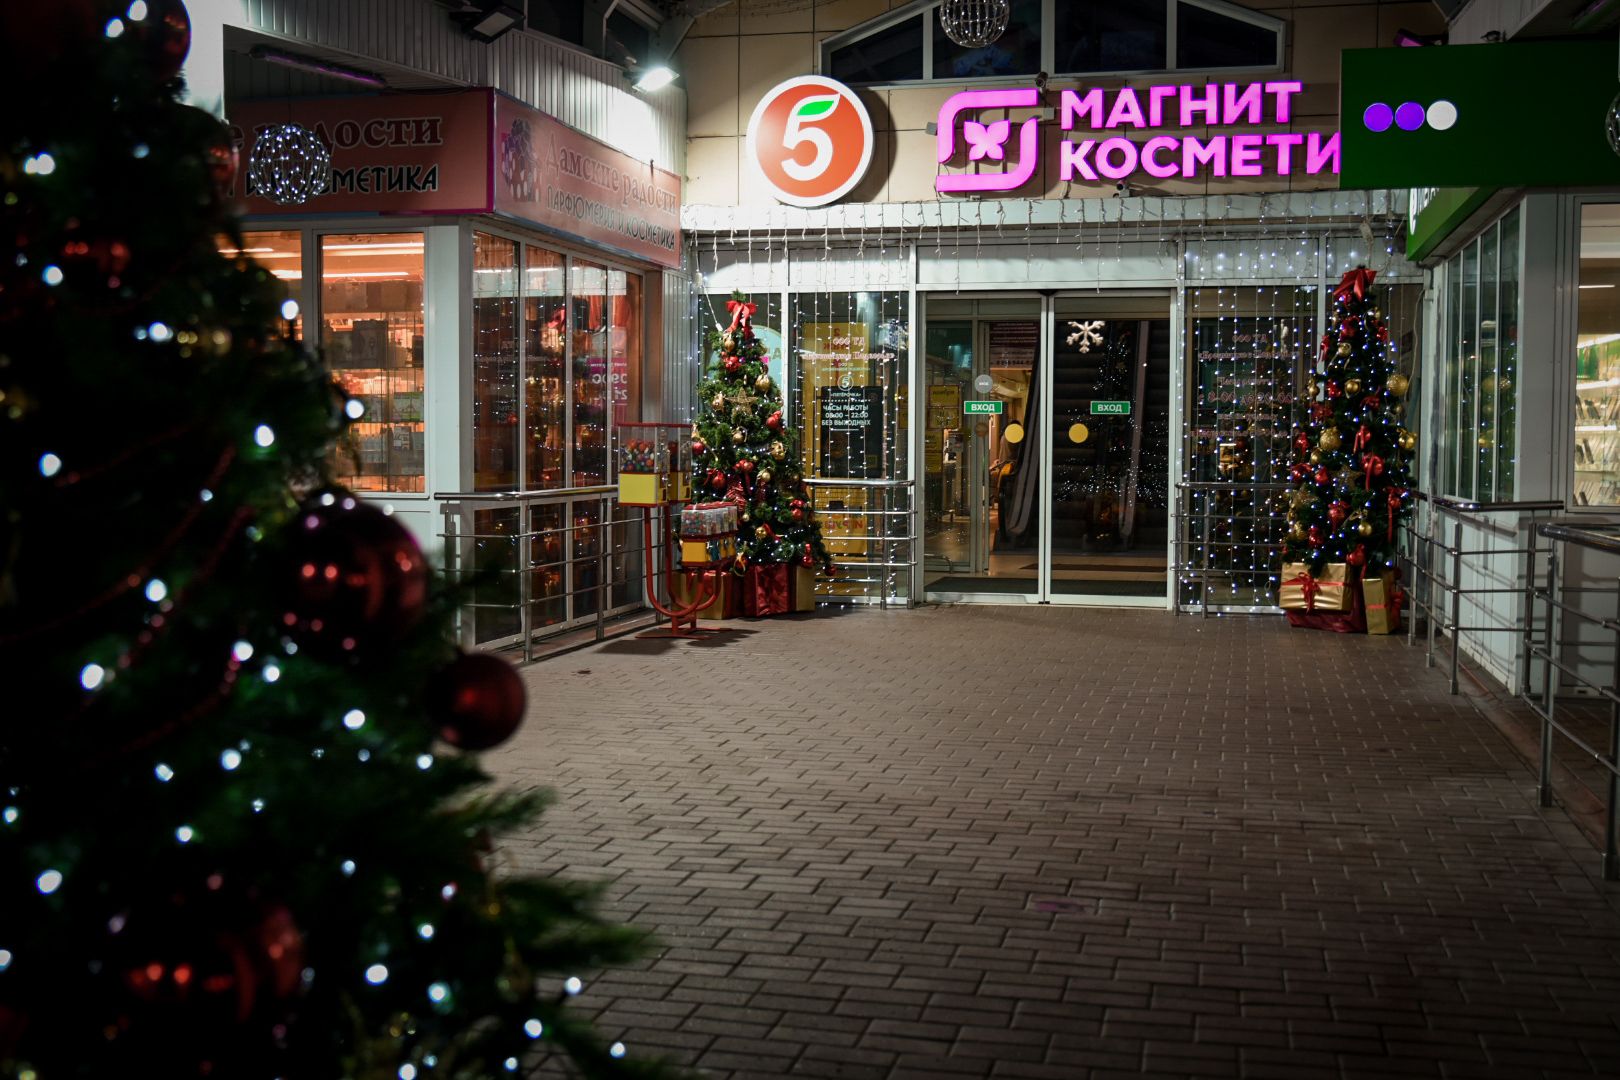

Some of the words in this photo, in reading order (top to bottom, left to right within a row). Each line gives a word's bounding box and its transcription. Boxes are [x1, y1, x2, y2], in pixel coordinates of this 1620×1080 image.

[1060, 81, 1303, 131] МАГНИТ
[780, 92, 841, 182] 5
[1060, 131, 1342, 182] КОСМЕТИ
[545, 132, 620, 192] Дамские
[622, 172, 677, 216] радости
[547, 183, 616, 232] ПАРФЮМЕРИЯ
[626, 214, 676, 252] КОСМЕТИКА
[971, 403, 995, 412] ВХОД
[1097, 403, 1122, 412] ВХОД
